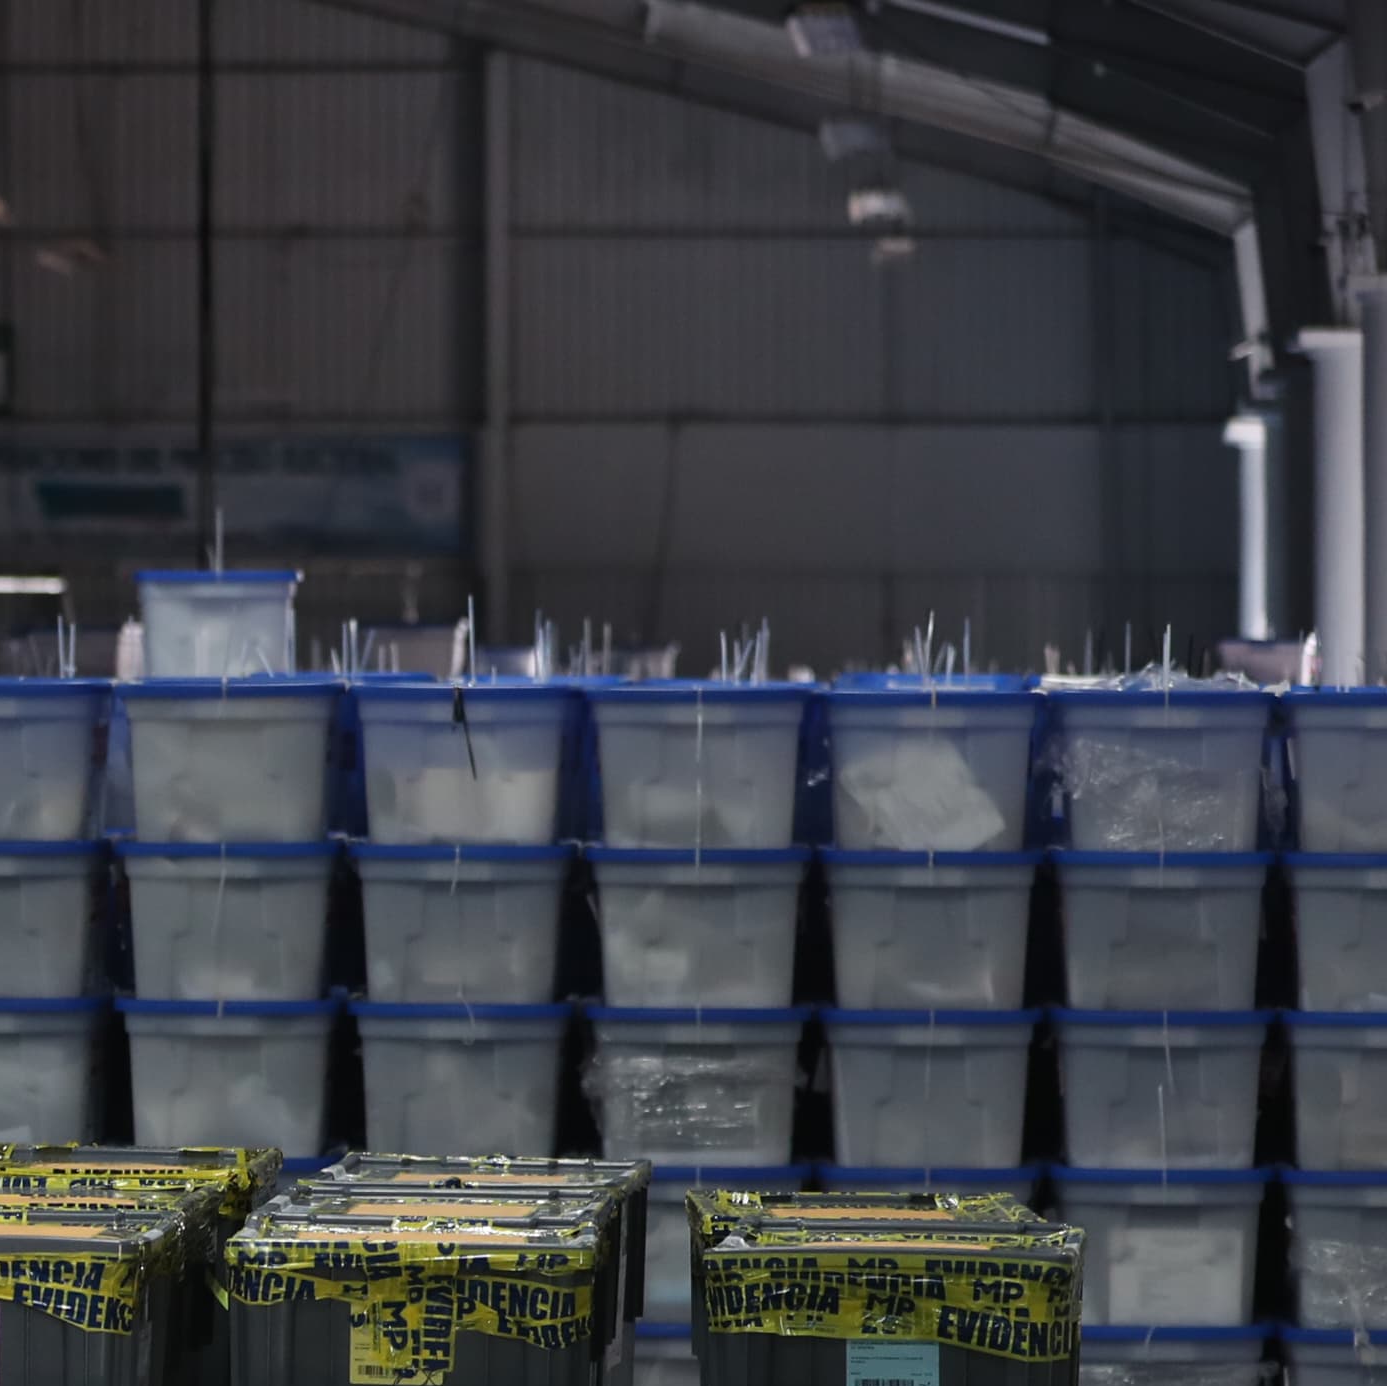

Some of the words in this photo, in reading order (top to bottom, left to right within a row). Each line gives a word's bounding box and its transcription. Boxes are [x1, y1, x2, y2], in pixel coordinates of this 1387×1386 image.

[13, 1282, 133, 1332] EVIDENC
[973, 1279, 1024, 1303] MP
[938, 1305, 1072, 1356] EVIDENCI
